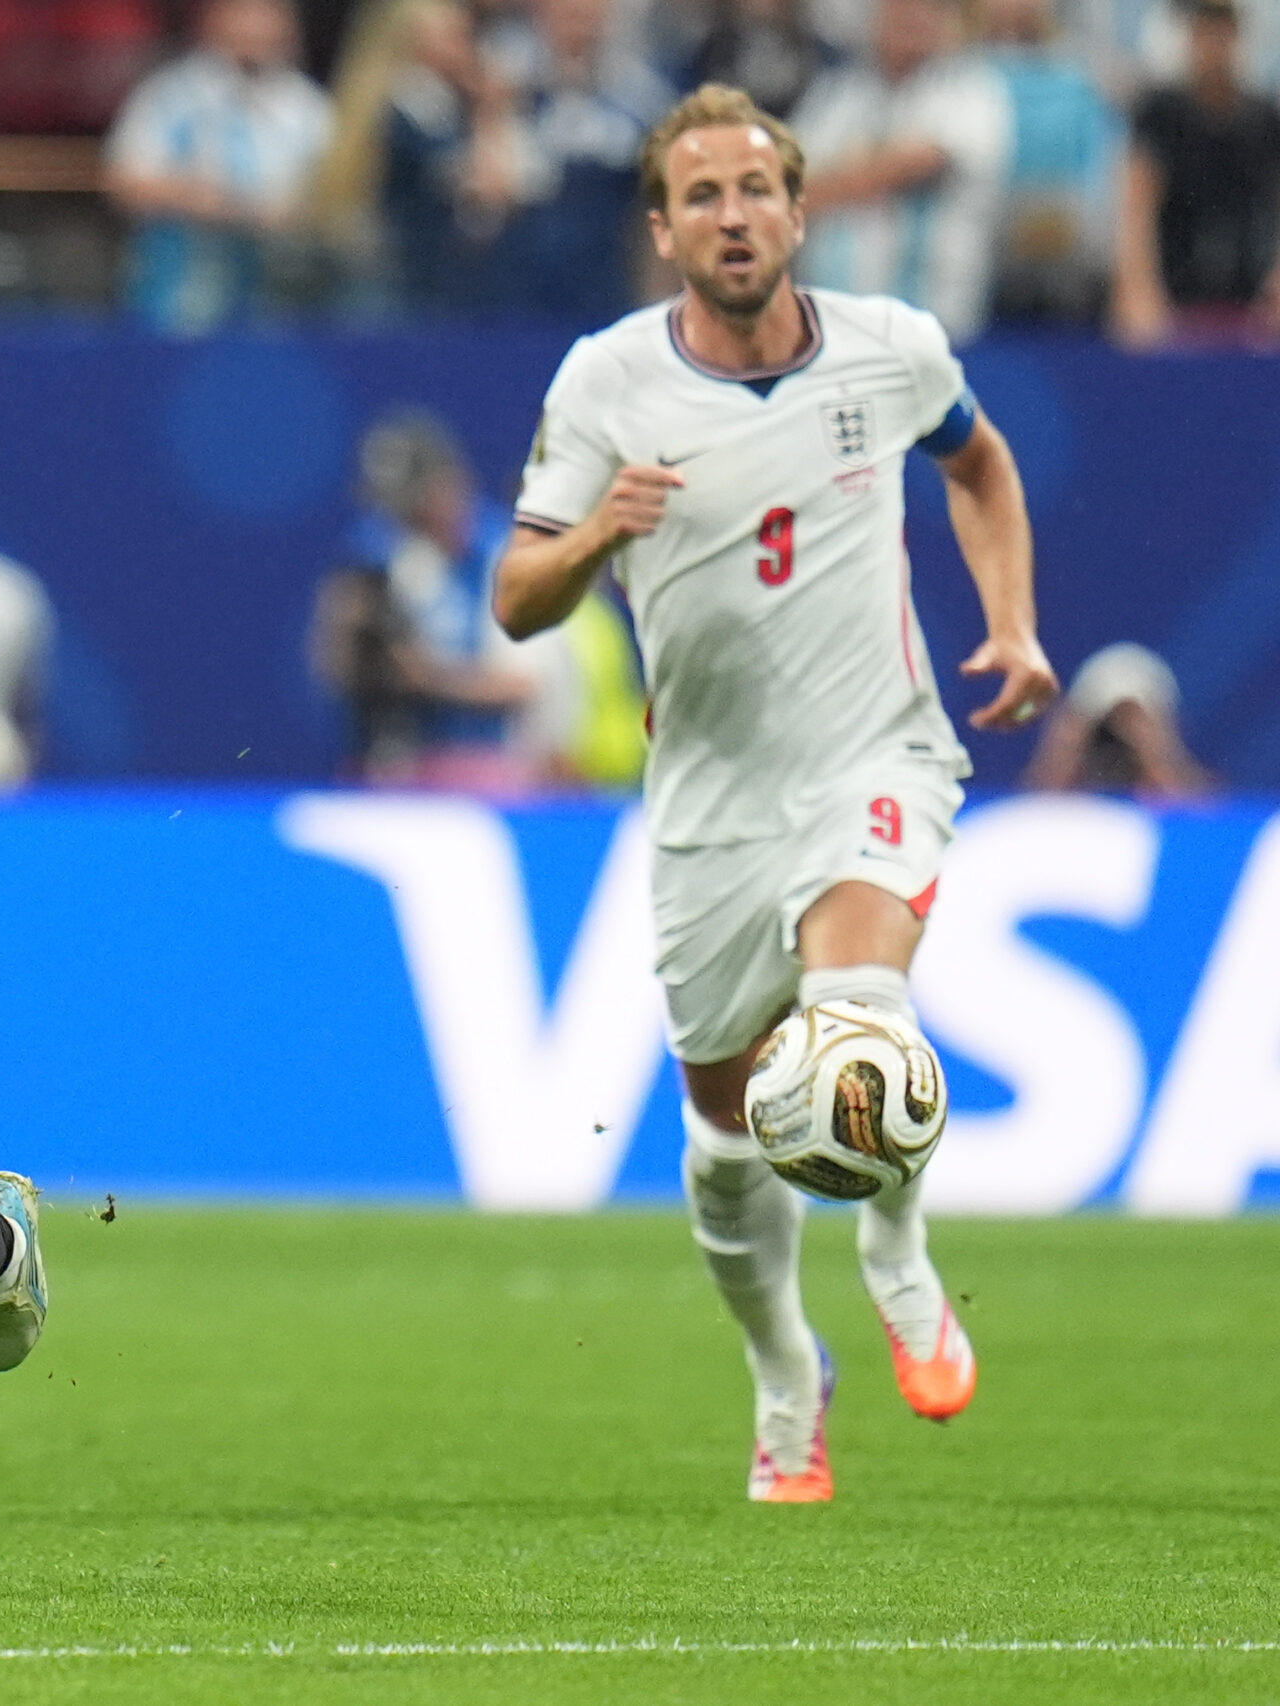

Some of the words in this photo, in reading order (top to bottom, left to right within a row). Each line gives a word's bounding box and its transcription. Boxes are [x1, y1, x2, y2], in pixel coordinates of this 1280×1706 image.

[757, 507, 794, 587] 9
[869, 797, 902, 846] 9
[276, 794, 1280, 1216] VS
